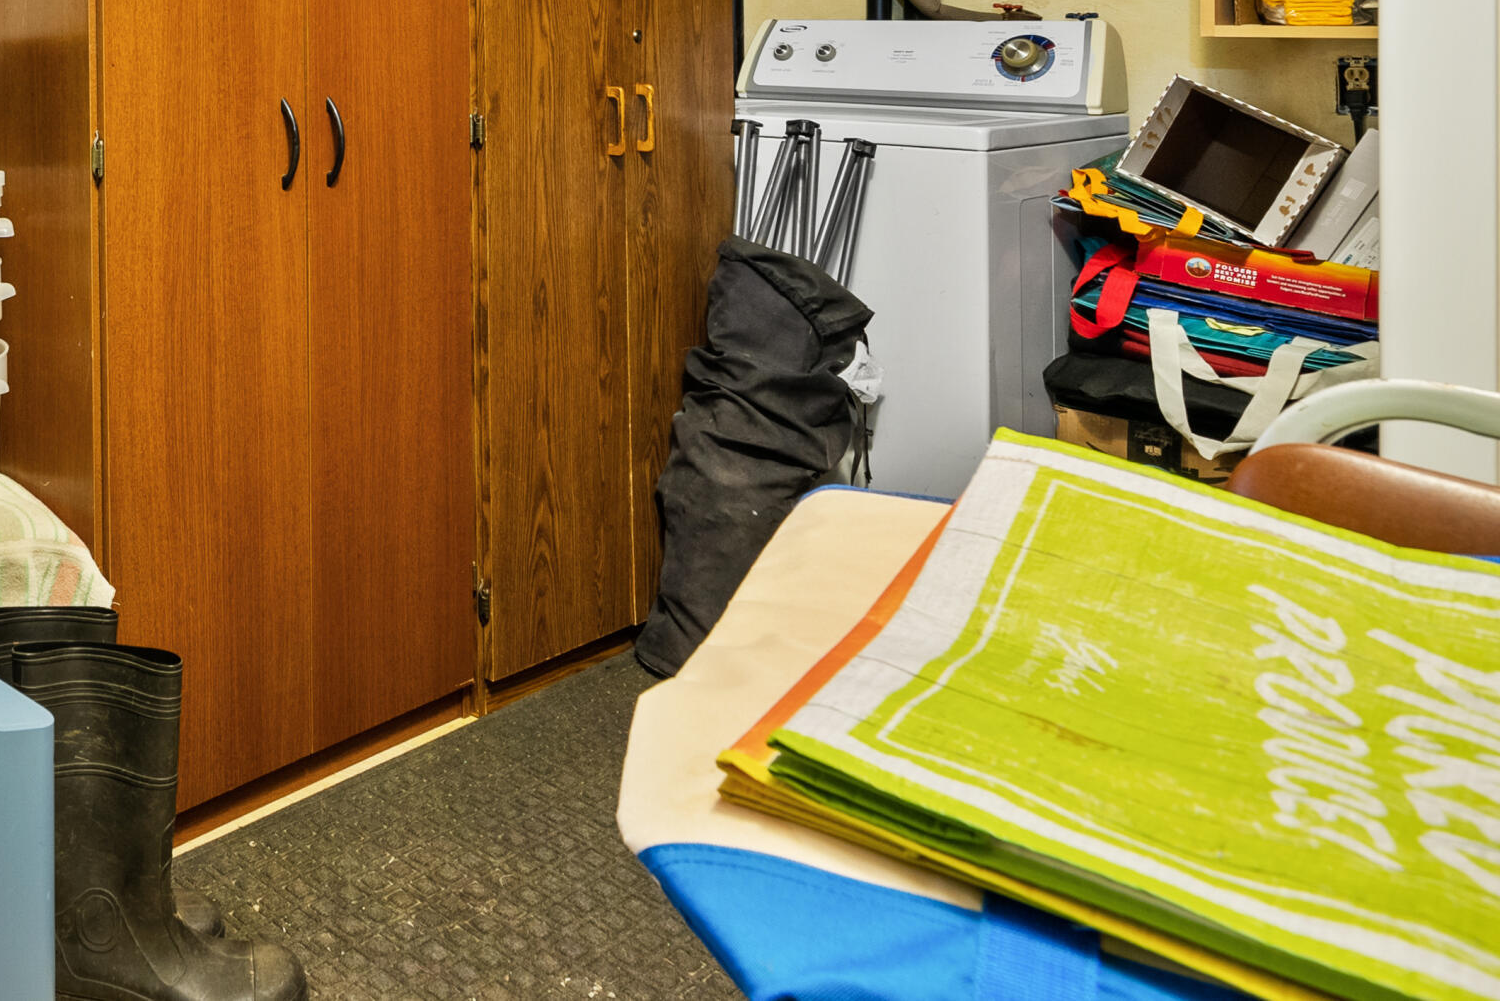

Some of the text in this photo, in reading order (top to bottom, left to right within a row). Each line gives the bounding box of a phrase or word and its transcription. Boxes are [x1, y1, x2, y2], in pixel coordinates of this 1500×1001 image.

[1214, 269, 1257, 281] BEST PART
[1215, 263, 1258, 276] FOLGERS
[1213, 274, 1257, 287] PROMISE
